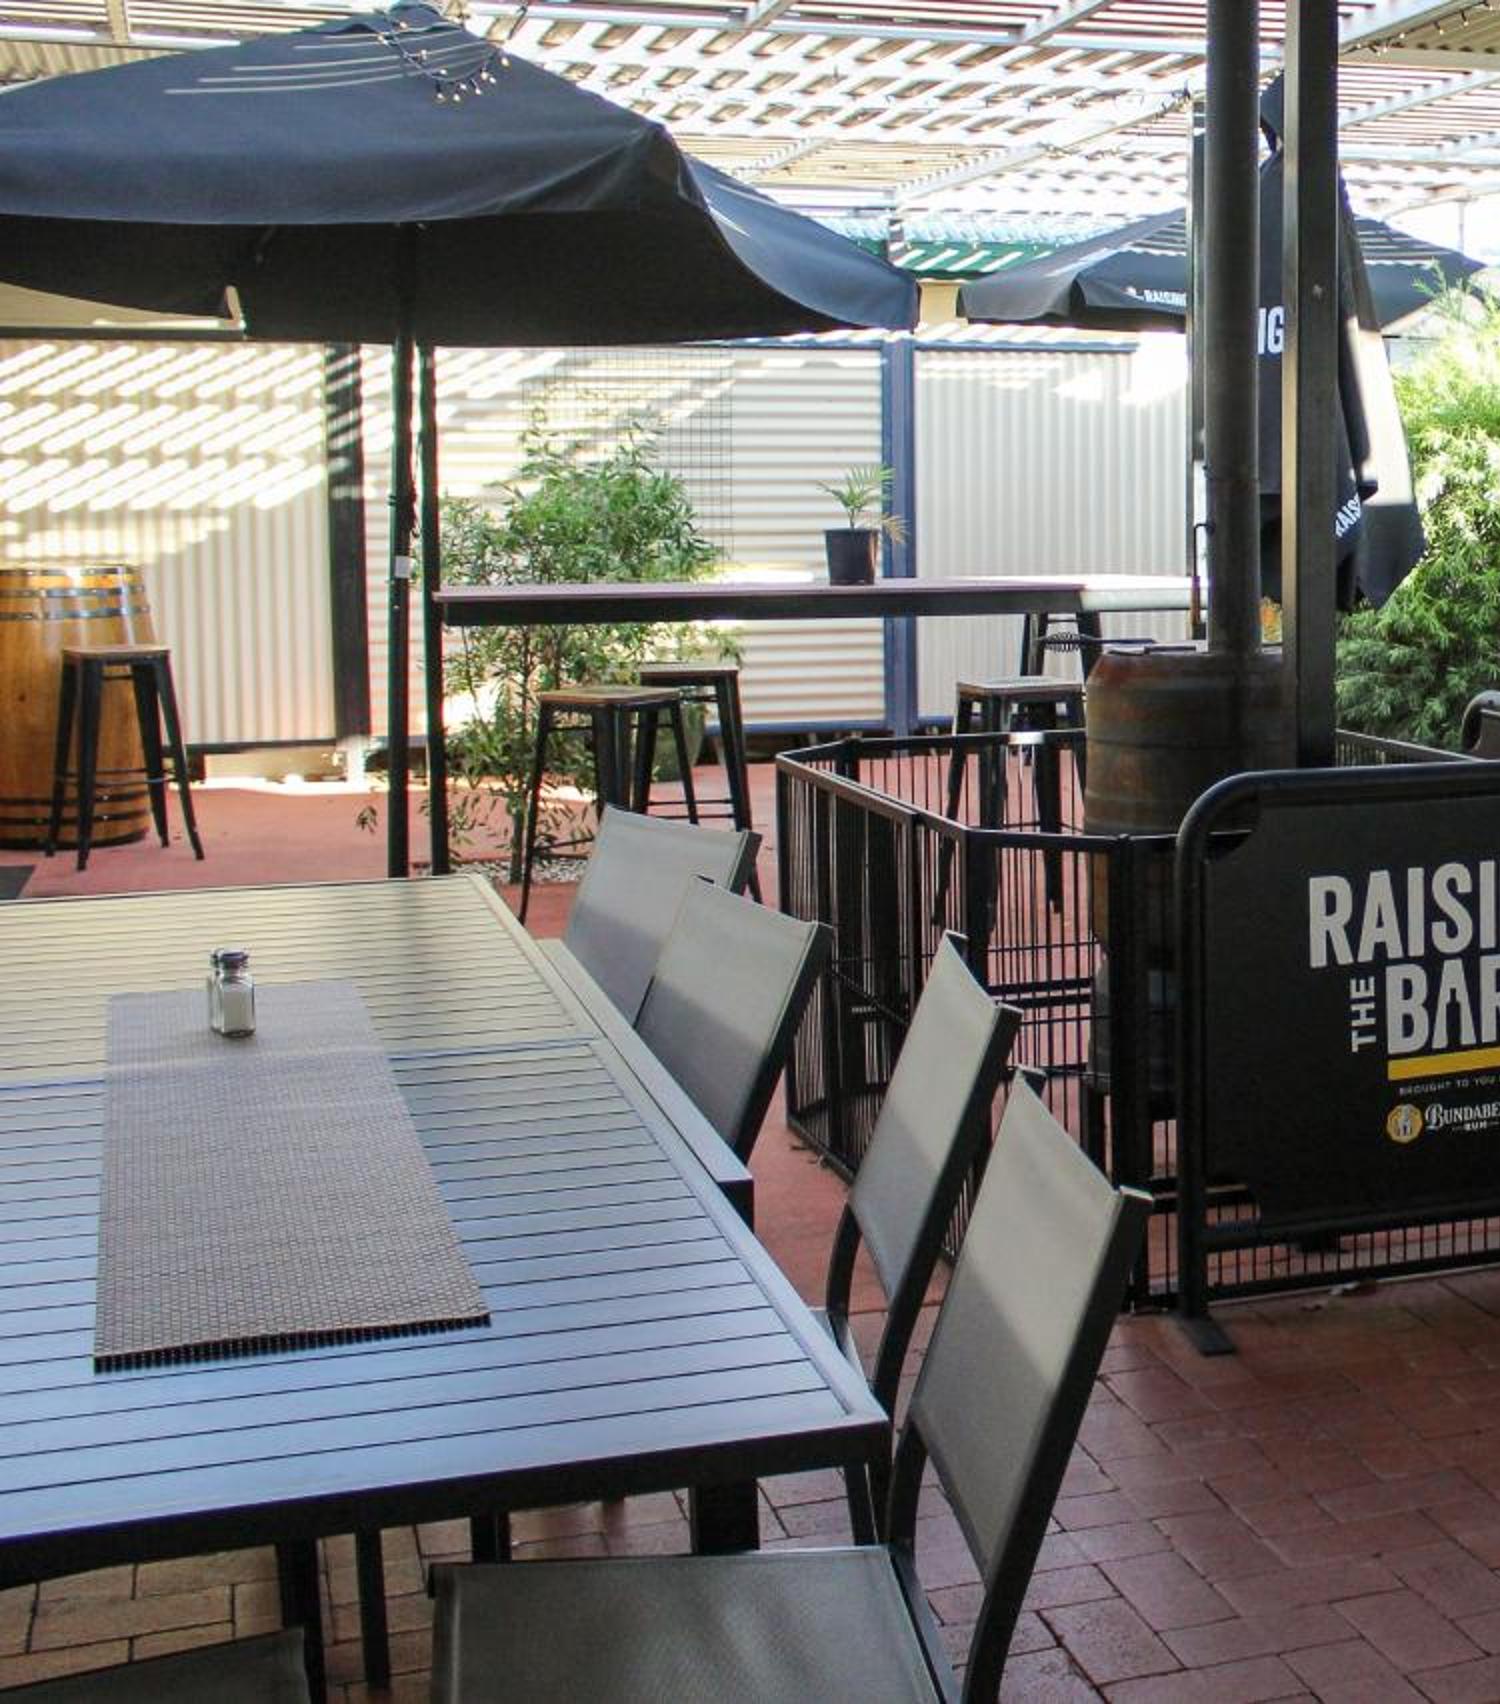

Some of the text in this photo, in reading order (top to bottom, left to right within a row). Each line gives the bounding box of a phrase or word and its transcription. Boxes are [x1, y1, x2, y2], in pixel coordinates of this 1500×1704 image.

[1350, 975, 1377, 1052] THE
[1399, 1081, 1452, 1096] BROUGHT
[1456, 1079, 1469, 1088] TO
[1475, 1075, 1496, 1086] YOU
[1464, 1121, 1488, 1131] RUM
